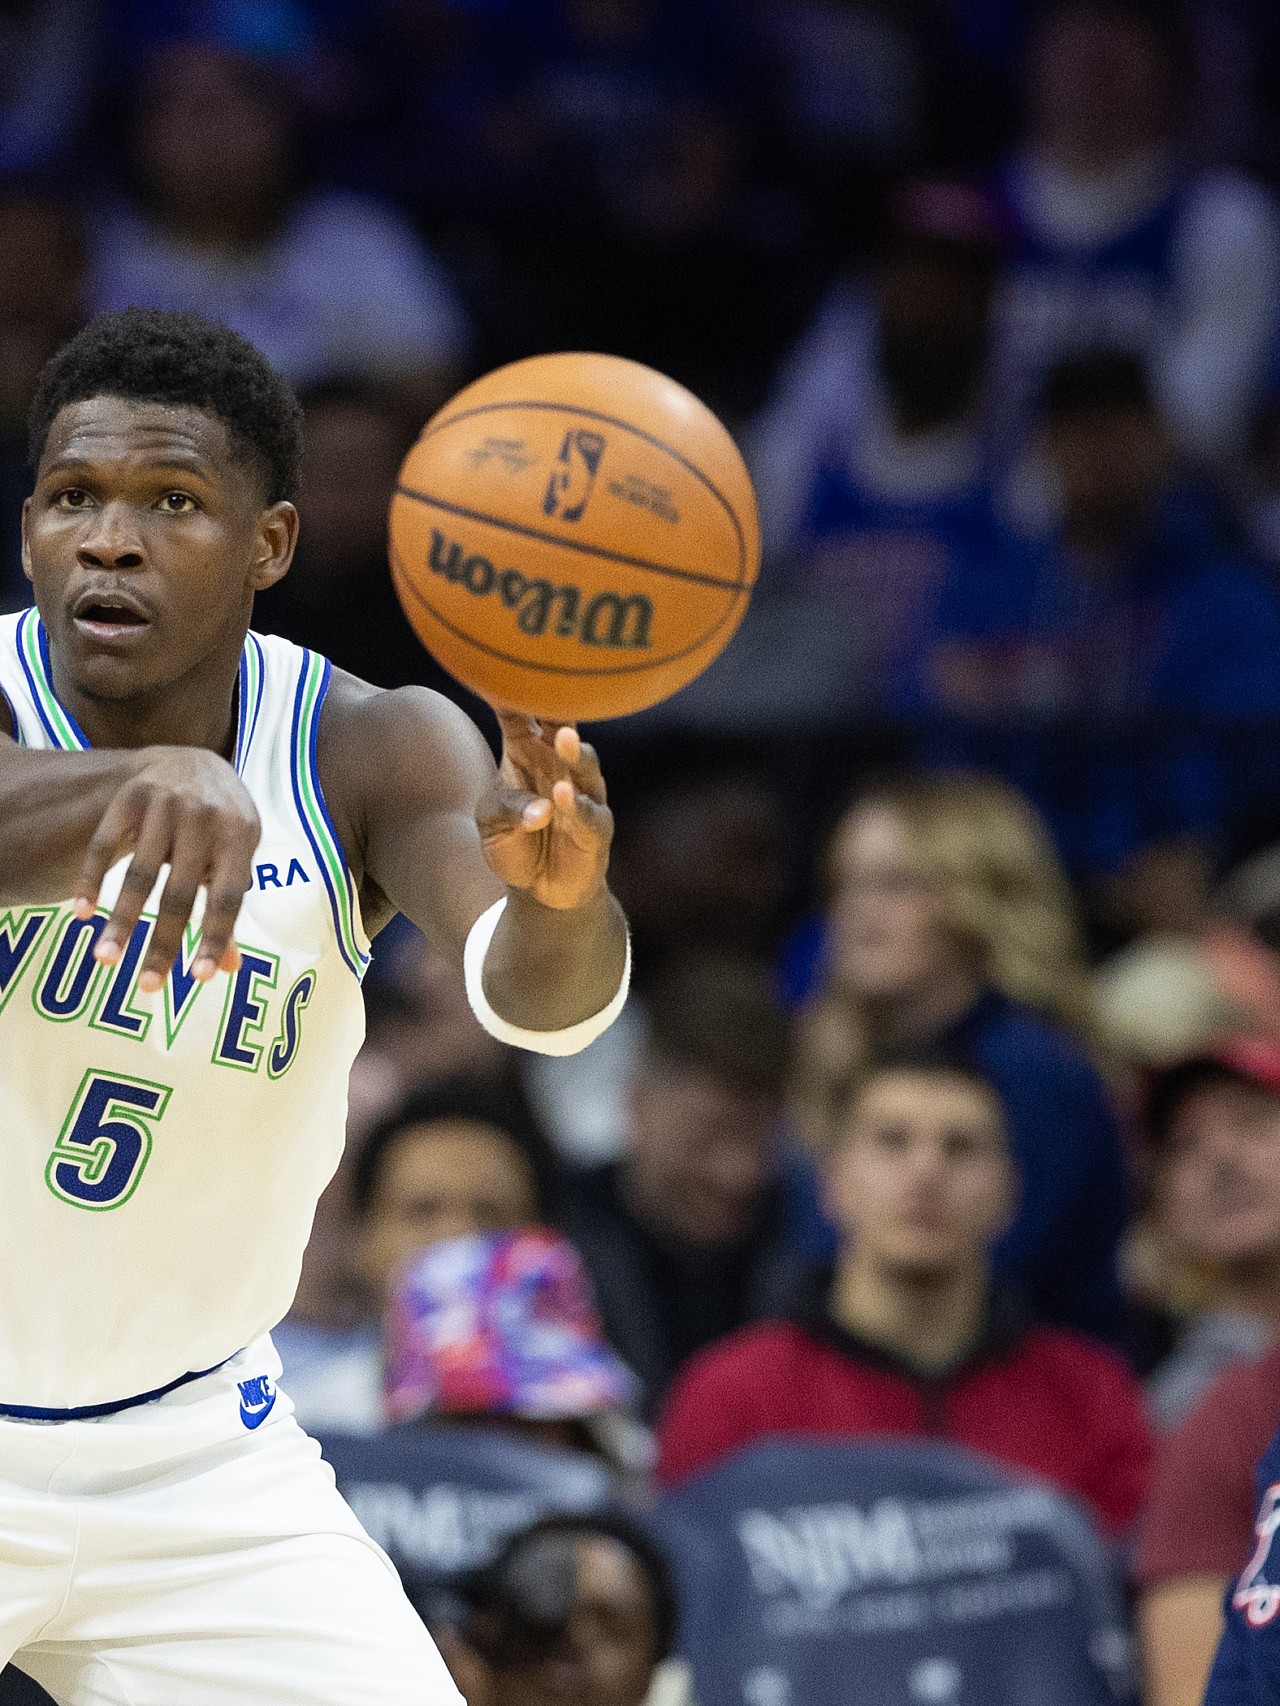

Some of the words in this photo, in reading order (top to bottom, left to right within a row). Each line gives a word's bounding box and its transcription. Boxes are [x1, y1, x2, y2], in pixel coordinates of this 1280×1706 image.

[427, 527, 654, 650] Wilson
[248, 857, 311, 891] RA
[44, 1067, 174, 1212] 5
[236, 1374, 273, 1408] NIKE
